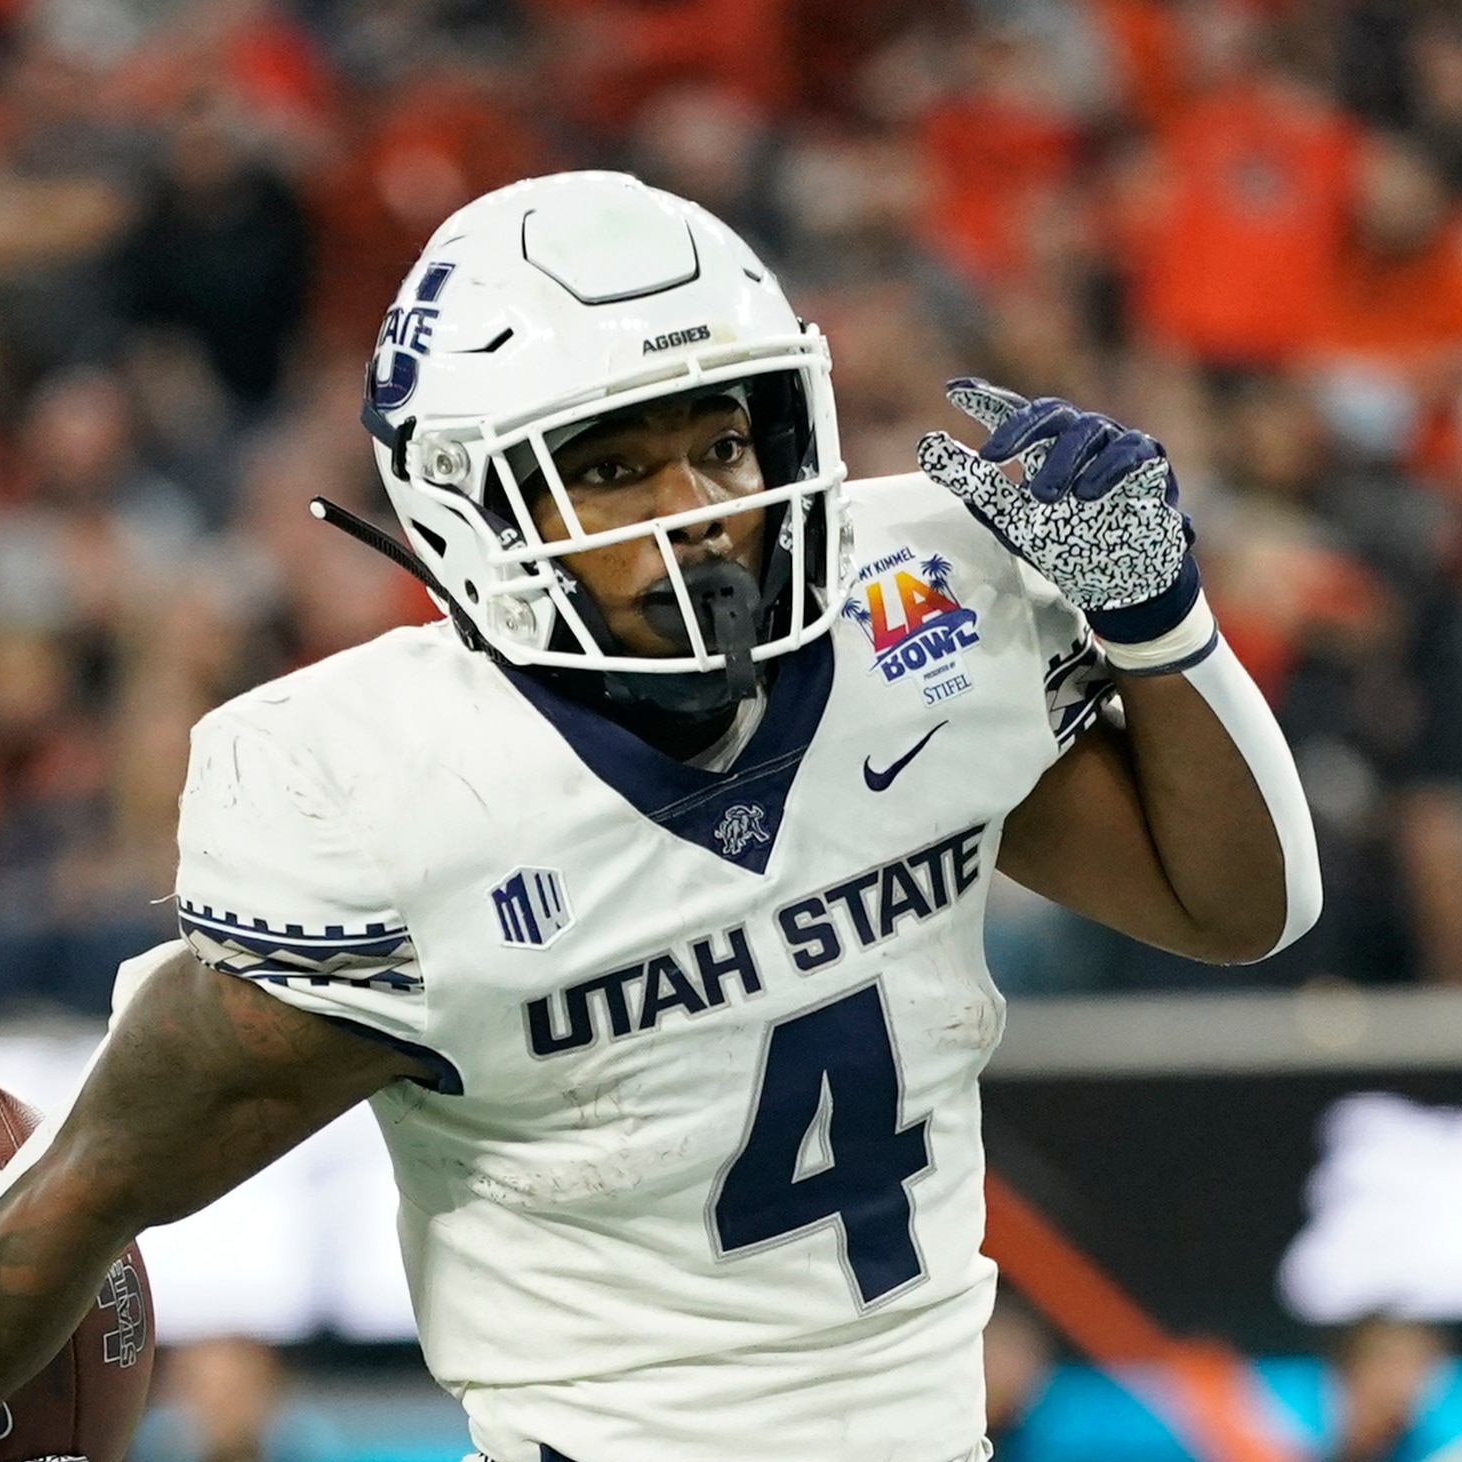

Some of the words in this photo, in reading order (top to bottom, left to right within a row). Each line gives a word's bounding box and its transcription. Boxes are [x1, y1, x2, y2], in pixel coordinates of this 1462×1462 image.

[379, 307, 440, 356] ATE
[642, 324, 711, 356] AGGIES
[873, 547, 916, 577] KIMMEL
[865, 571, 962, 653] LA
[880, 628, 980, 682] BOWL
[923, 674, 972, 705] STIFEL
[522, 923, 767, 1061] UTAH
[773, 823, 988, 977] STATE
[704, 974, 938, 1317] 4
